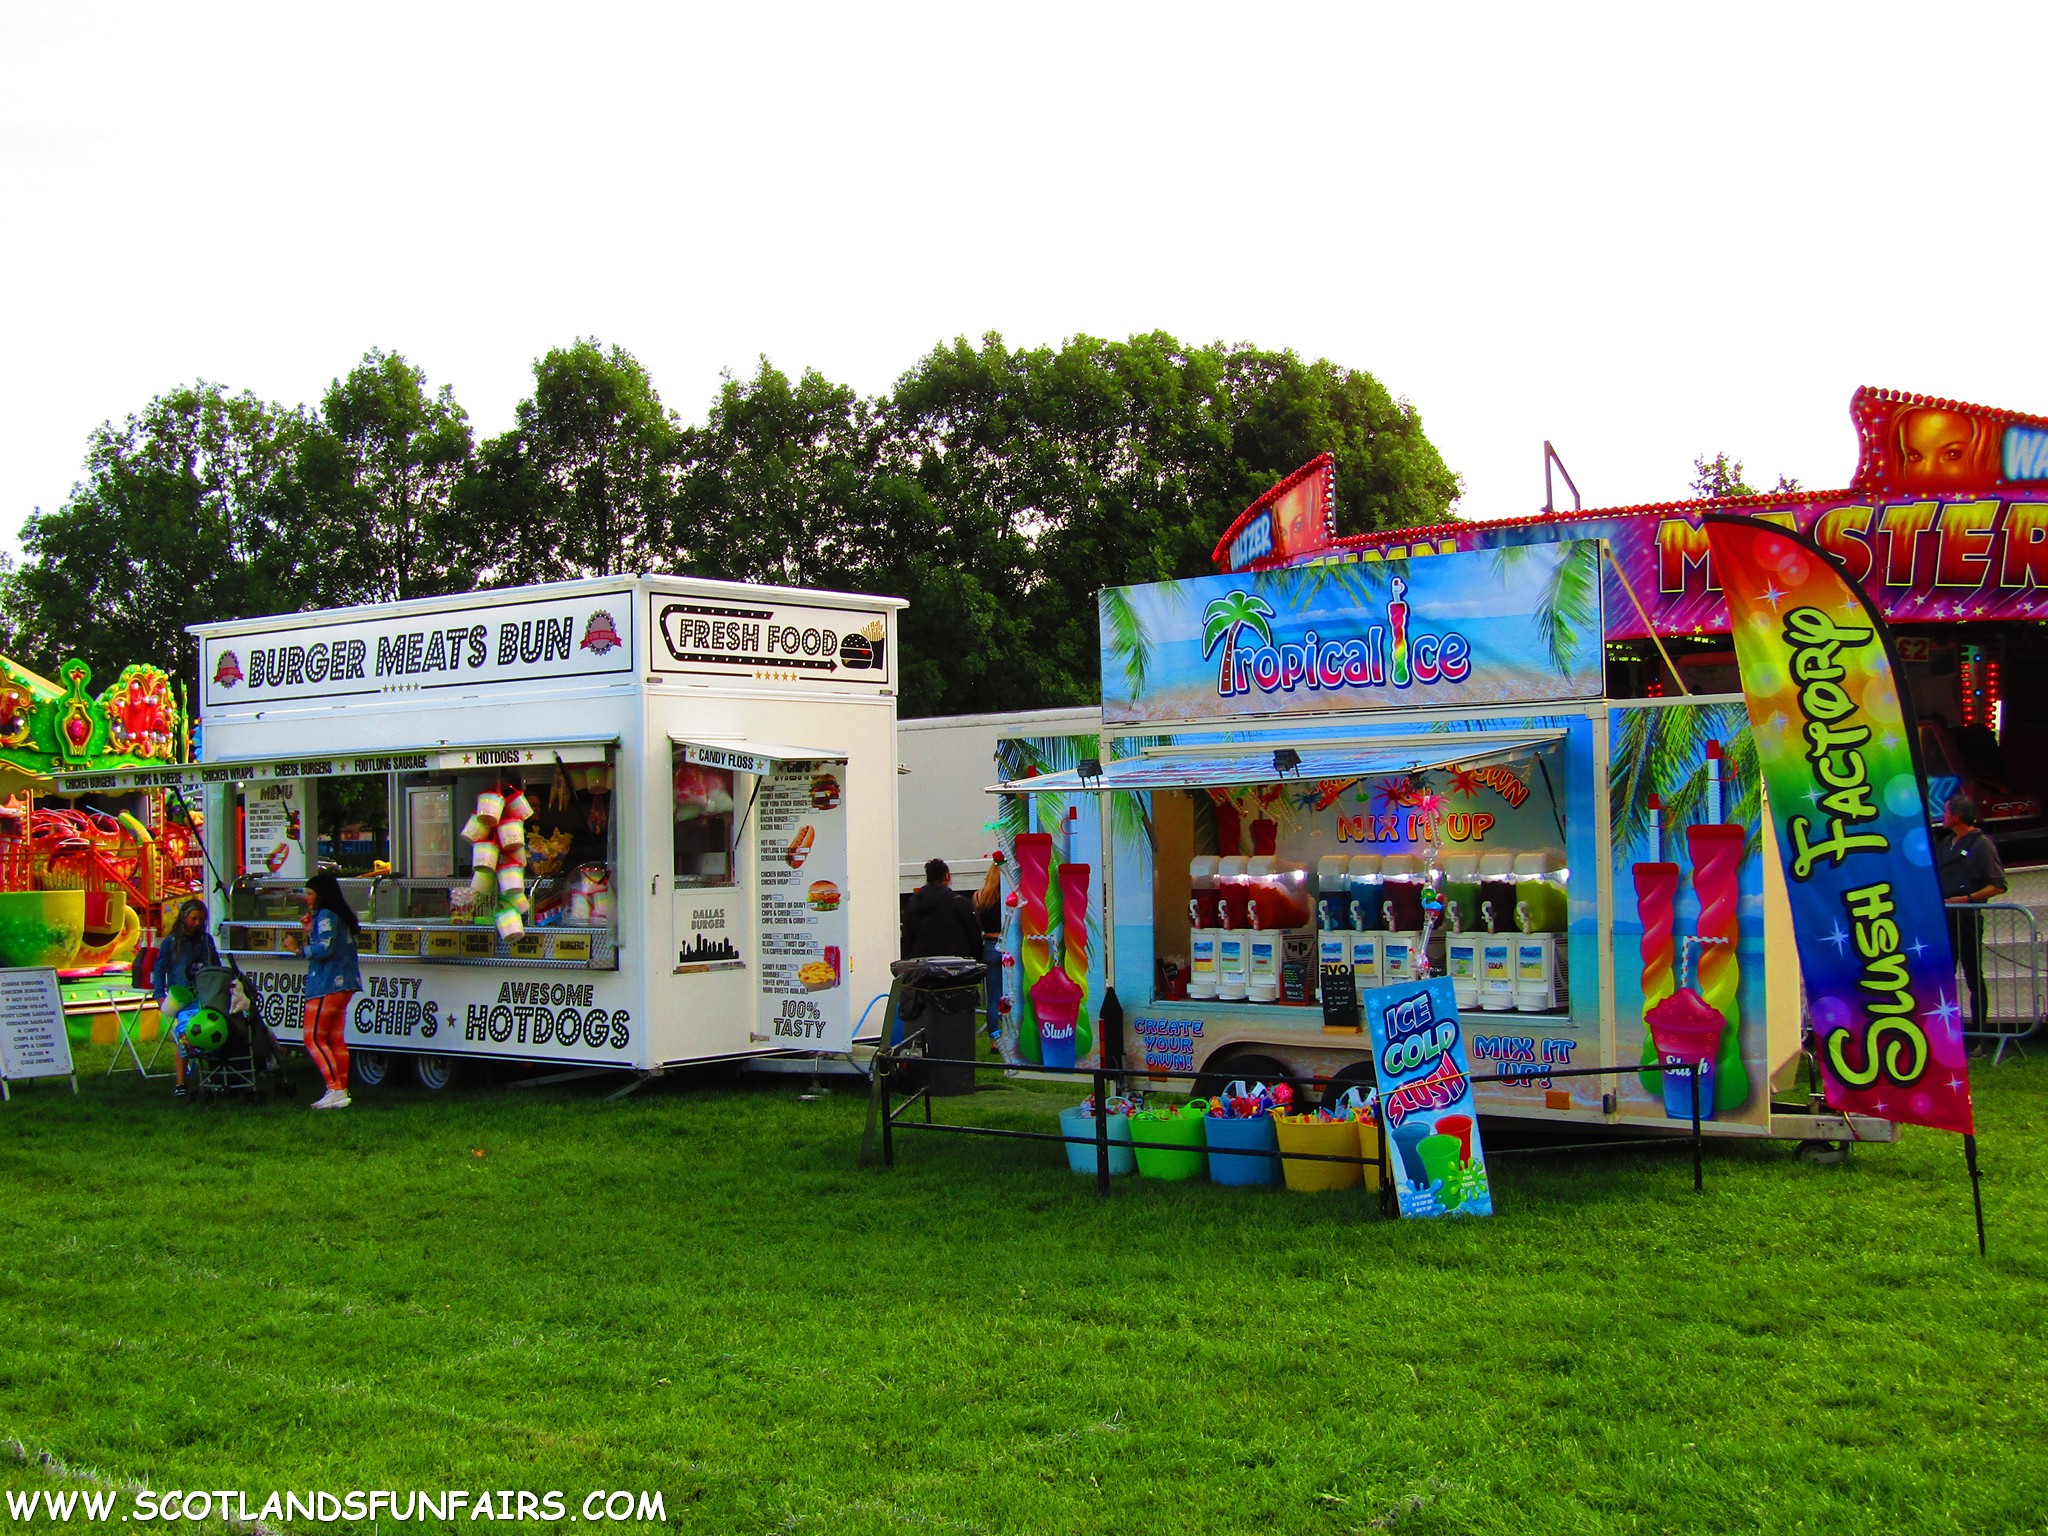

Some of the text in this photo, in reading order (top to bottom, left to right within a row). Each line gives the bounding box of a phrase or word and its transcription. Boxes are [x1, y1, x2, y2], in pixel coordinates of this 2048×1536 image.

[1654, 501, 2048, 592] MSTER
[680, 618, 838, 657] FRESH FOOD
[1202, 577, 1471, 697] Tropical Ice
[249, 616, 574, 688] BURGER MEATS BUN
[1786, 605, 1892, 883] FACTORY
[354, 755, 428, 772] FOOTLONG SAUSAGE
[476, 750, 520, 765] HOTDOGS
[699, 748, 753, 771] CANDY FLOSS
[787, 761, 811, 773] CHIPS
[134, 771, 183, 786] CHIPS & CHEESE
[202, 766, 254, 782] CHICKEN WRAPS
[274, 761, 332, 777] CHEESE BURGERS
[65, 775, 116, 791] CHICKEN BURGERS
[261, 784, 293, 800] MENU
[1337, 814, 1399, 843] MIX
[1447, 813, 1495, 843] UP
[691, 918, 725, 931] BURGER
[692, 908, 725, 920] DALLAS
[518, 945, 537, 954] WRAPS
[560, 941, 585, 950] BURGERS
[369, 976, 422, 999] TASTY
[497, 981, 593, 1007] AWESOME
[354, 998, 438, 1038] CHIPS
[781, 1000, 820, 1020] 100%
[1385, 992, 1434, 1040] ICE
[465, 1004, 630, 1049] HOTDOGS
[774, 1018, 826, 1039] TASTY
[1041, 1021, 1074, 1040] Slush
[1133, 1016, 1204, 1037] CREATE
[1143, 1035, 1194, 1053] YOUR
[1383, 1020, 1458, 1075] COLD
[1473, 1034, 1577, 1064] MIX IT
[1145, 1052, 1193, 1071] OWN!
[1664, 1054, 1711, 1077] Sluh
[1496, 1062, 1553, 1089] UP!
[1386, 1050, 1468, 1129] SLUSH
